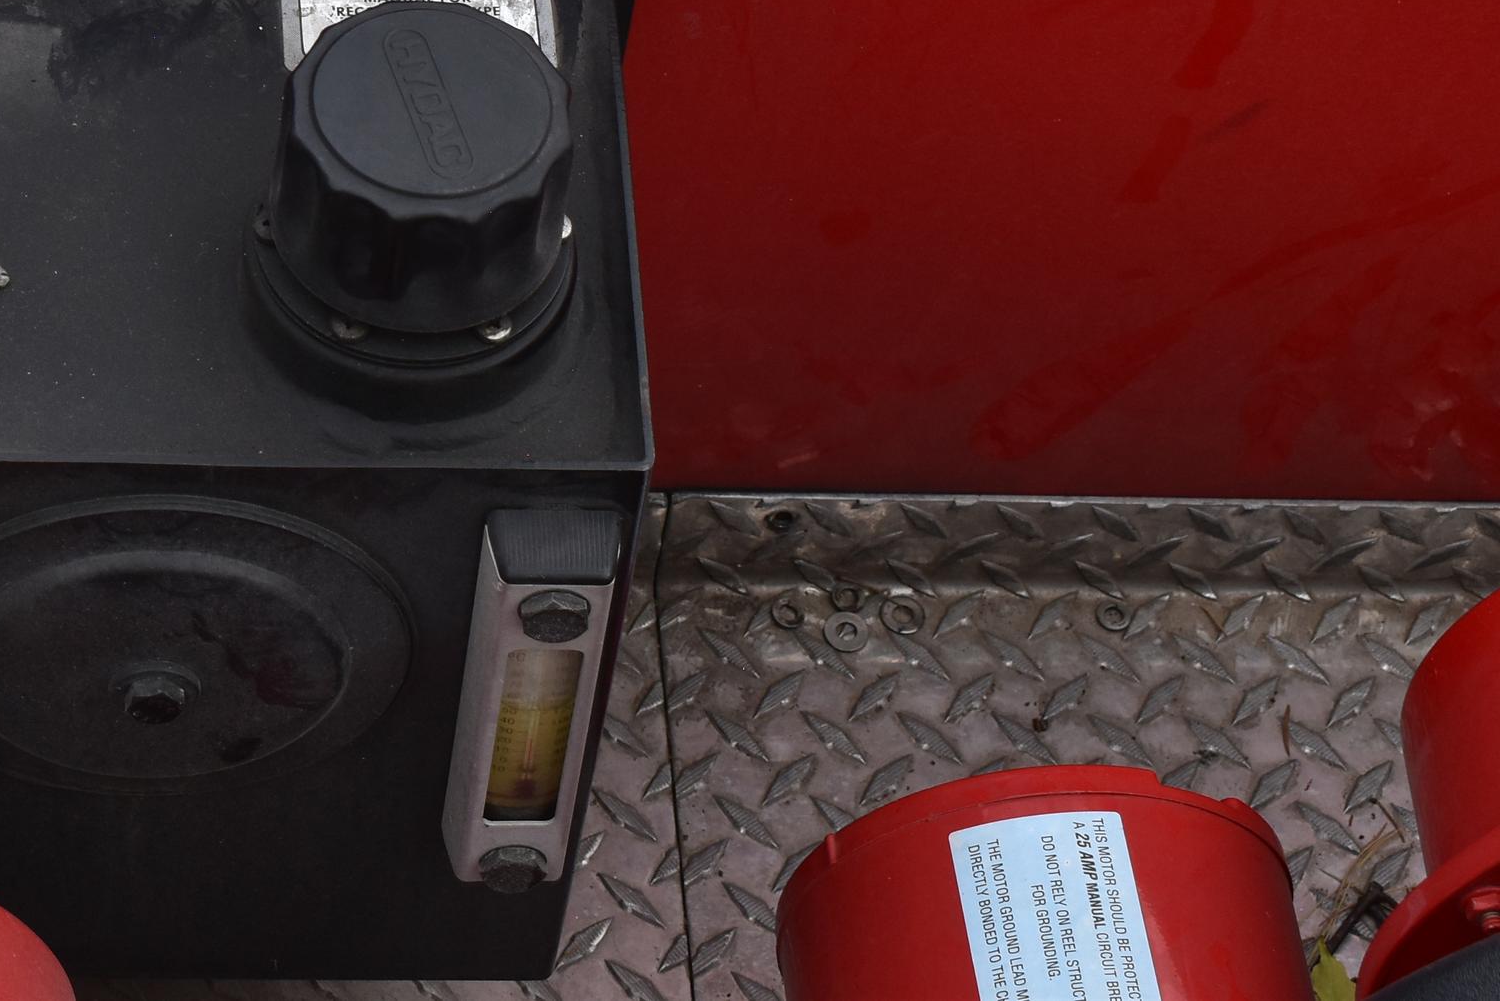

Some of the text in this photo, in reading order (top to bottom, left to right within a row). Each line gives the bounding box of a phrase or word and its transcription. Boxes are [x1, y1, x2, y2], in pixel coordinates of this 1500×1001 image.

[388, 36, 470, 169] HYDAC
[1072, 821, 1086, 830] A
[1075, 832, 1092, 849] 25
[986, 838, 1003, 862] THE
[1040, 835, 1056, 852] DO
[967, 844, 990, 896] DIRECTLY
[1044, 854, 1061, 876] NOT
[1078, 850, 1099, 881] AMP
[990, 862, 1011, 905] MOTOR
[1049, 879, 1068, 907] RELY
[1056, 909, 1072, 926] ON
[1085, 882, 1107, 930] MANUAL
[1091, 817, 1143, 1001] THIS MOTOR SHOULD BE PROTEC
[978, 899, 998, 946] BONDED
[999, 906, 1020, 955] GROUND
[1030, 884, 1061, 981] FOR GROUNDING.
[987, 946, 1002, 964] TO
[1060, 928, 1077, 958] REEL
[1096, 932, 1118, 978] CIRCUIT
[991, 964, 1008, 989] THE
[1009, 957, 1027, 987] LEAD
